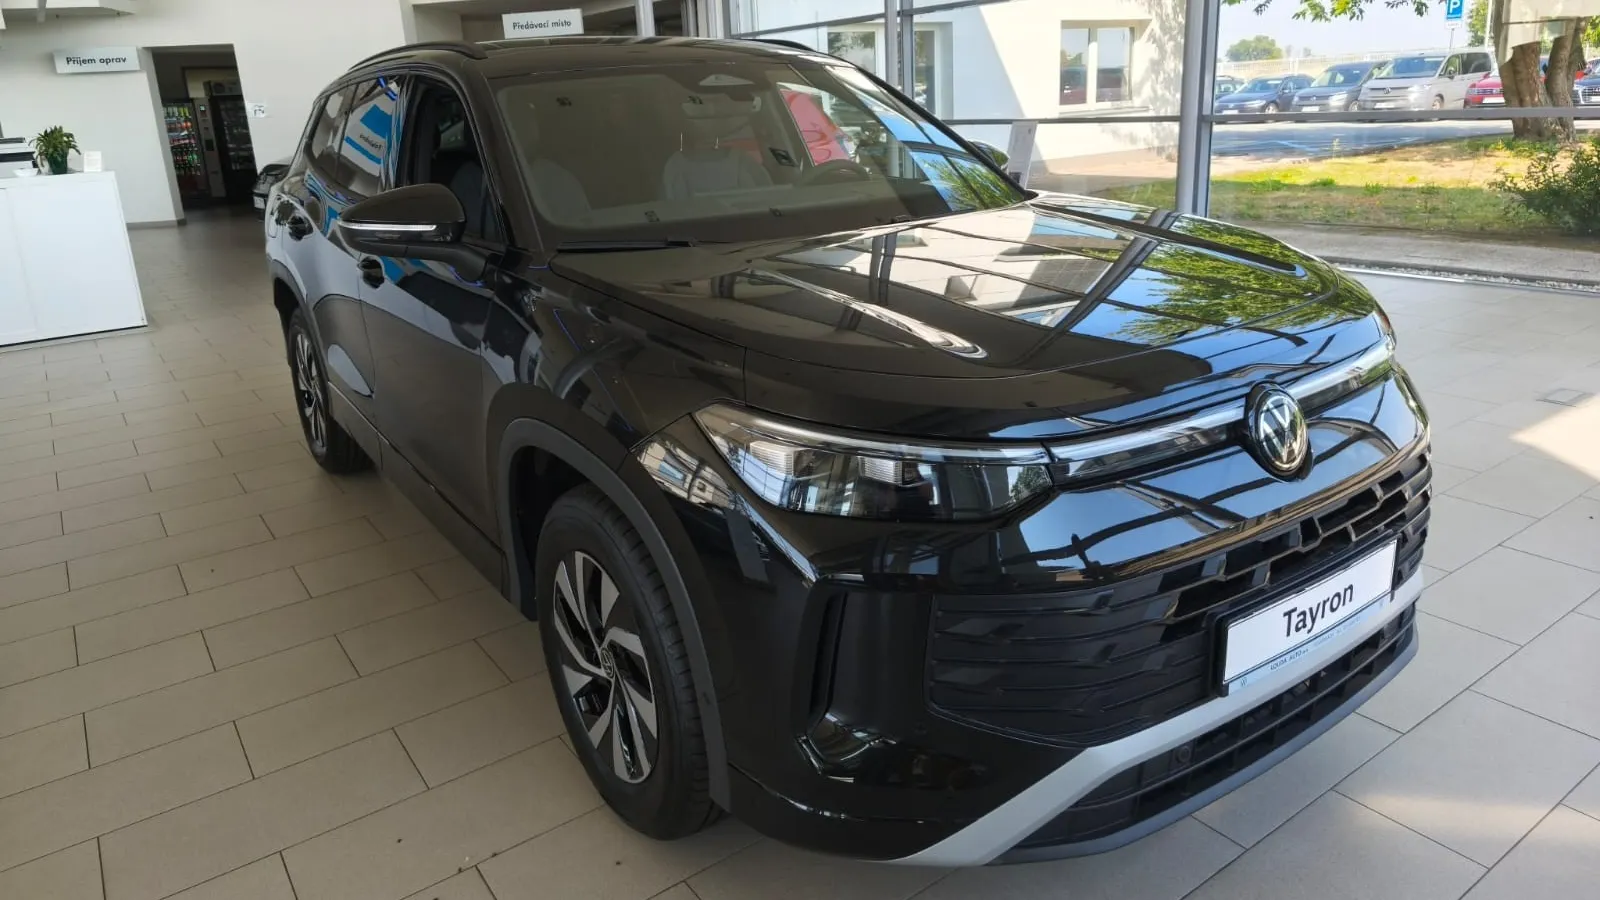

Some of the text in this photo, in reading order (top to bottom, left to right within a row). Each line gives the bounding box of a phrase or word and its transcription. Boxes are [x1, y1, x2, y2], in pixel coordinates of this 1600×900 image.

[1450, 0, 1461, 14] P
[551, 18, 572, 30] místo
[98, 57, 127, 66] oprav
[1283, 583, 1354, 638] Tayron
